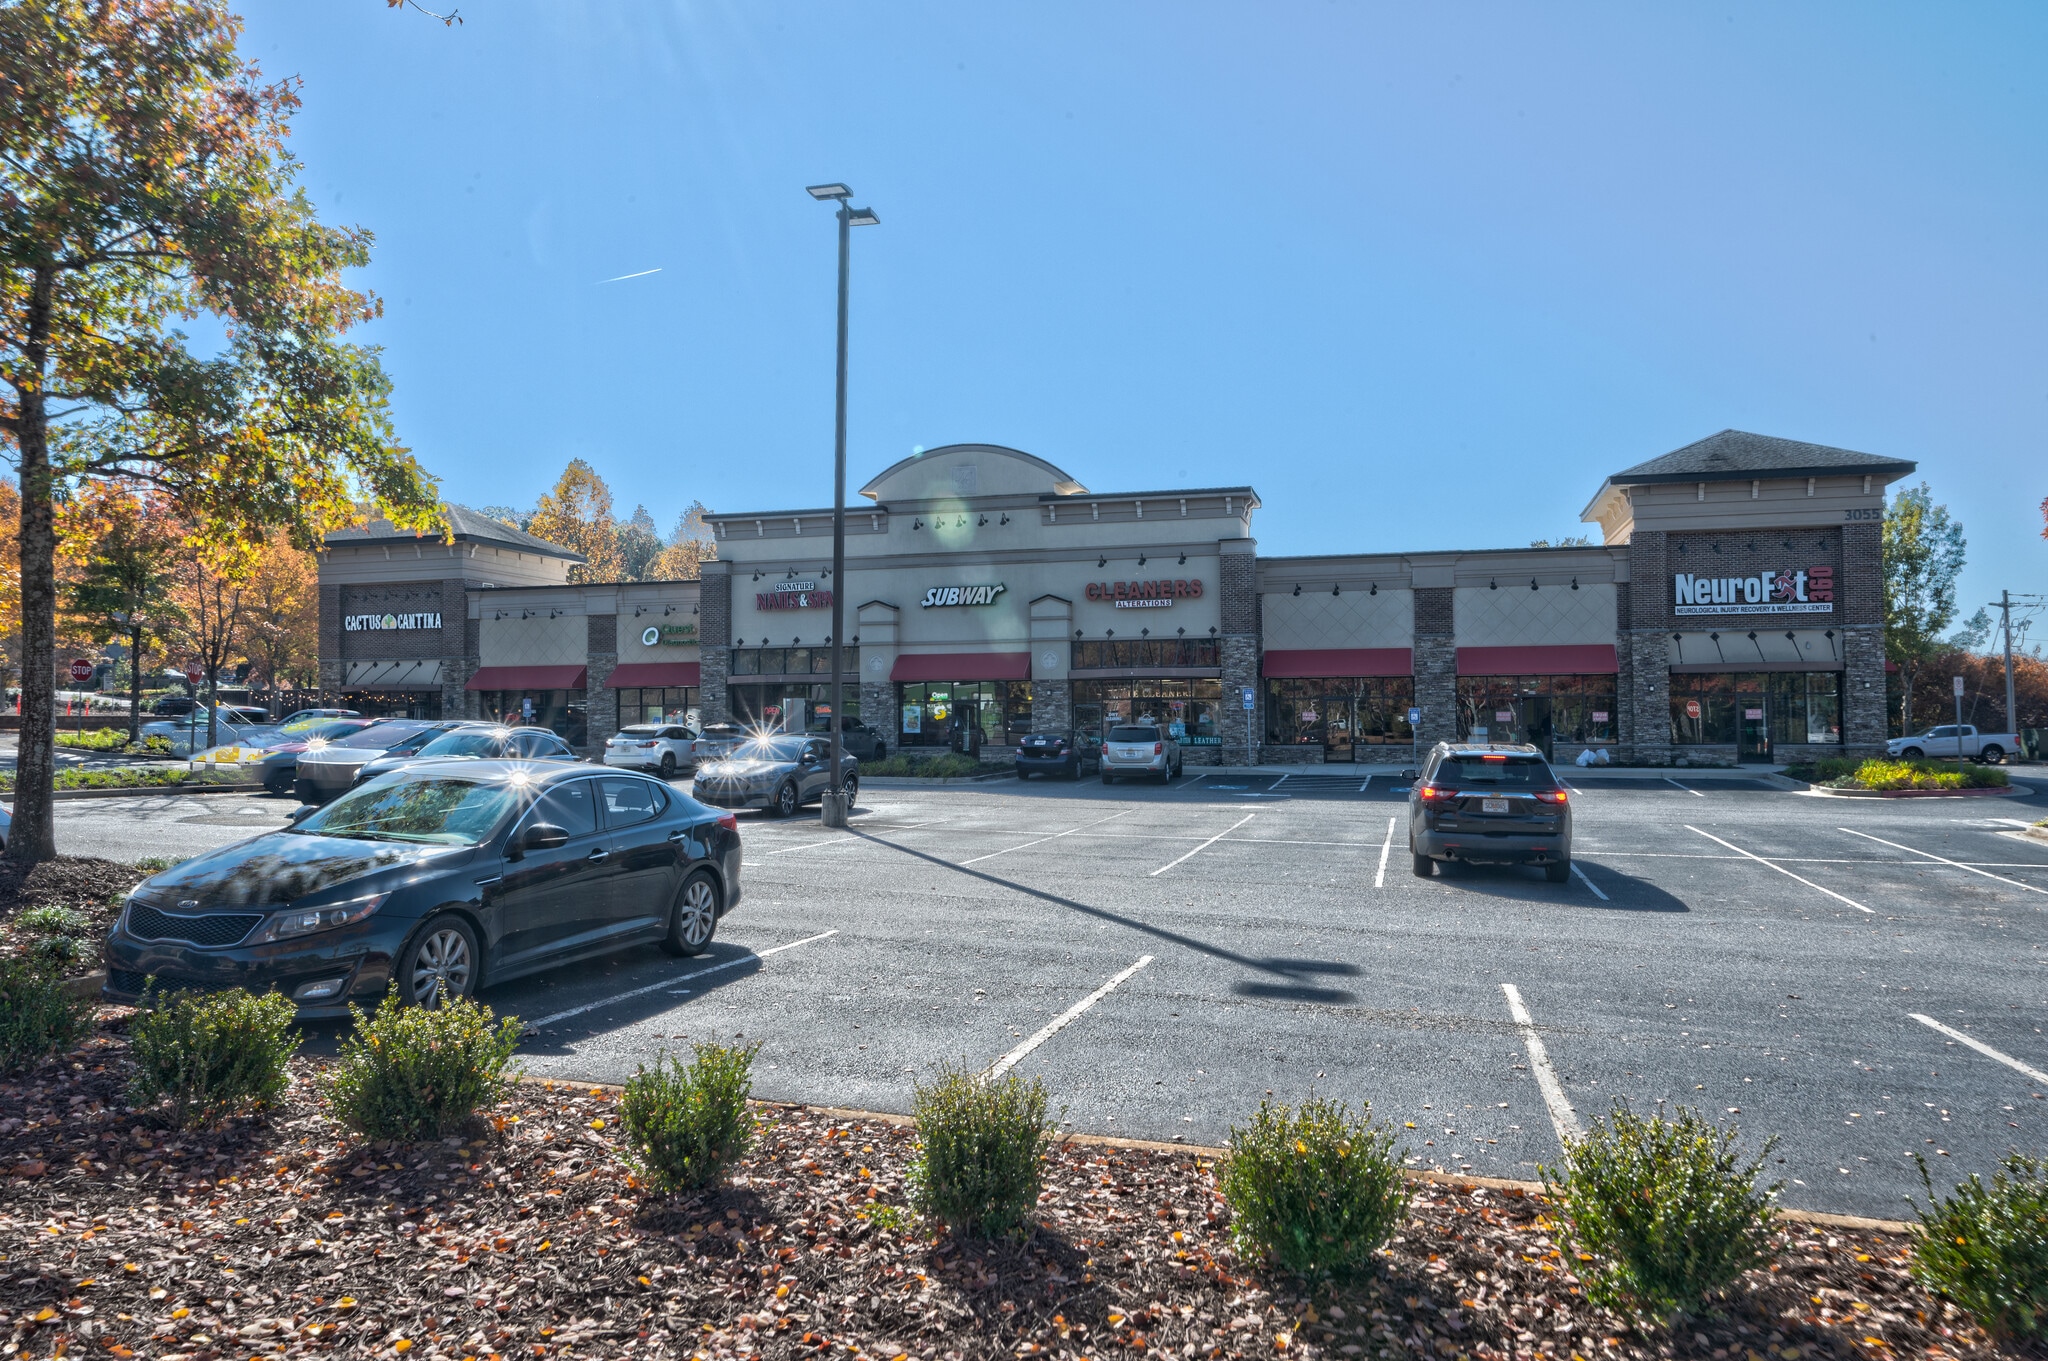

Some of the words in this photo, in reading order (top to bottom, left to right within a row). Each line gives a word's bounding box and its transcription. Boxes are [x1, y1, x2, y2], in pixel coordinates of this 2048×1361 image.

[1844, 509, 1880, 520] 3055
[775, 583, 814, 591] SIGNATURE
[1808, 566, 1833, 601] 360
[1085, 579, 1203, 600] CLEANERS
[756, 592, 799, 610] NAILS
[800, 594, 807, 606] &
[921, 584, 1005, 607] SUBWAY
[1117, 600, 1171, 608] ALTERATIONS
[1740, 605, 1770, 613] RECOVERY
[345, 614, 381, 631] CACTUS
[397, 613, 442, 629] CANTINA
[661, 624, 694, 634] Quest
[72, 665, 92, 675] STOP
[188, 662, 202, 674] STOP
